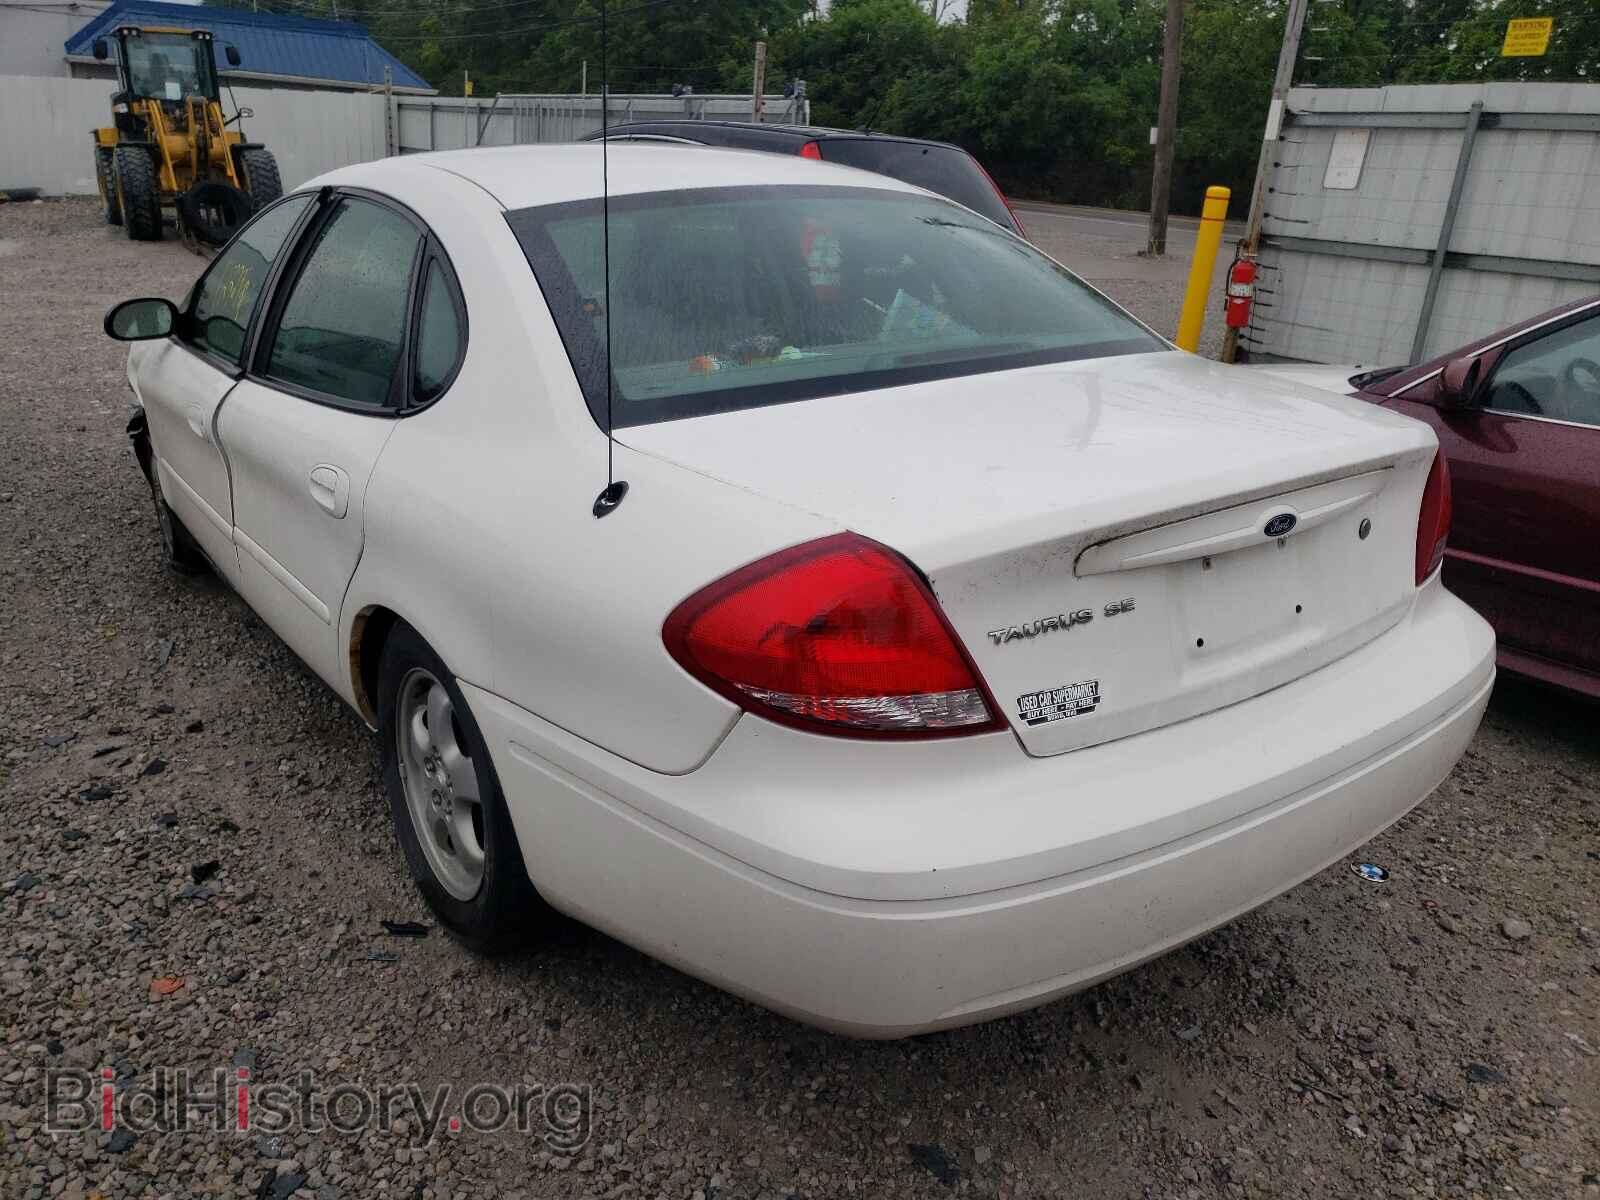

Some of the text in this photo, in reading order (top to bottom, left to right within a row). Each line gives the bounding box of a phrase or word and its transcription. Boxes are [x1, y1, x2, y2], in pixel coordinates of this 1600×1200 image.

[987, 598, 1136, 645] TAURUS SE
[1020, 682, 1096, 711] USED CAR SUPERMARKET
[1027, 710, 1041, 718] BUY
[1065, 702, 1078, 710] PAY
